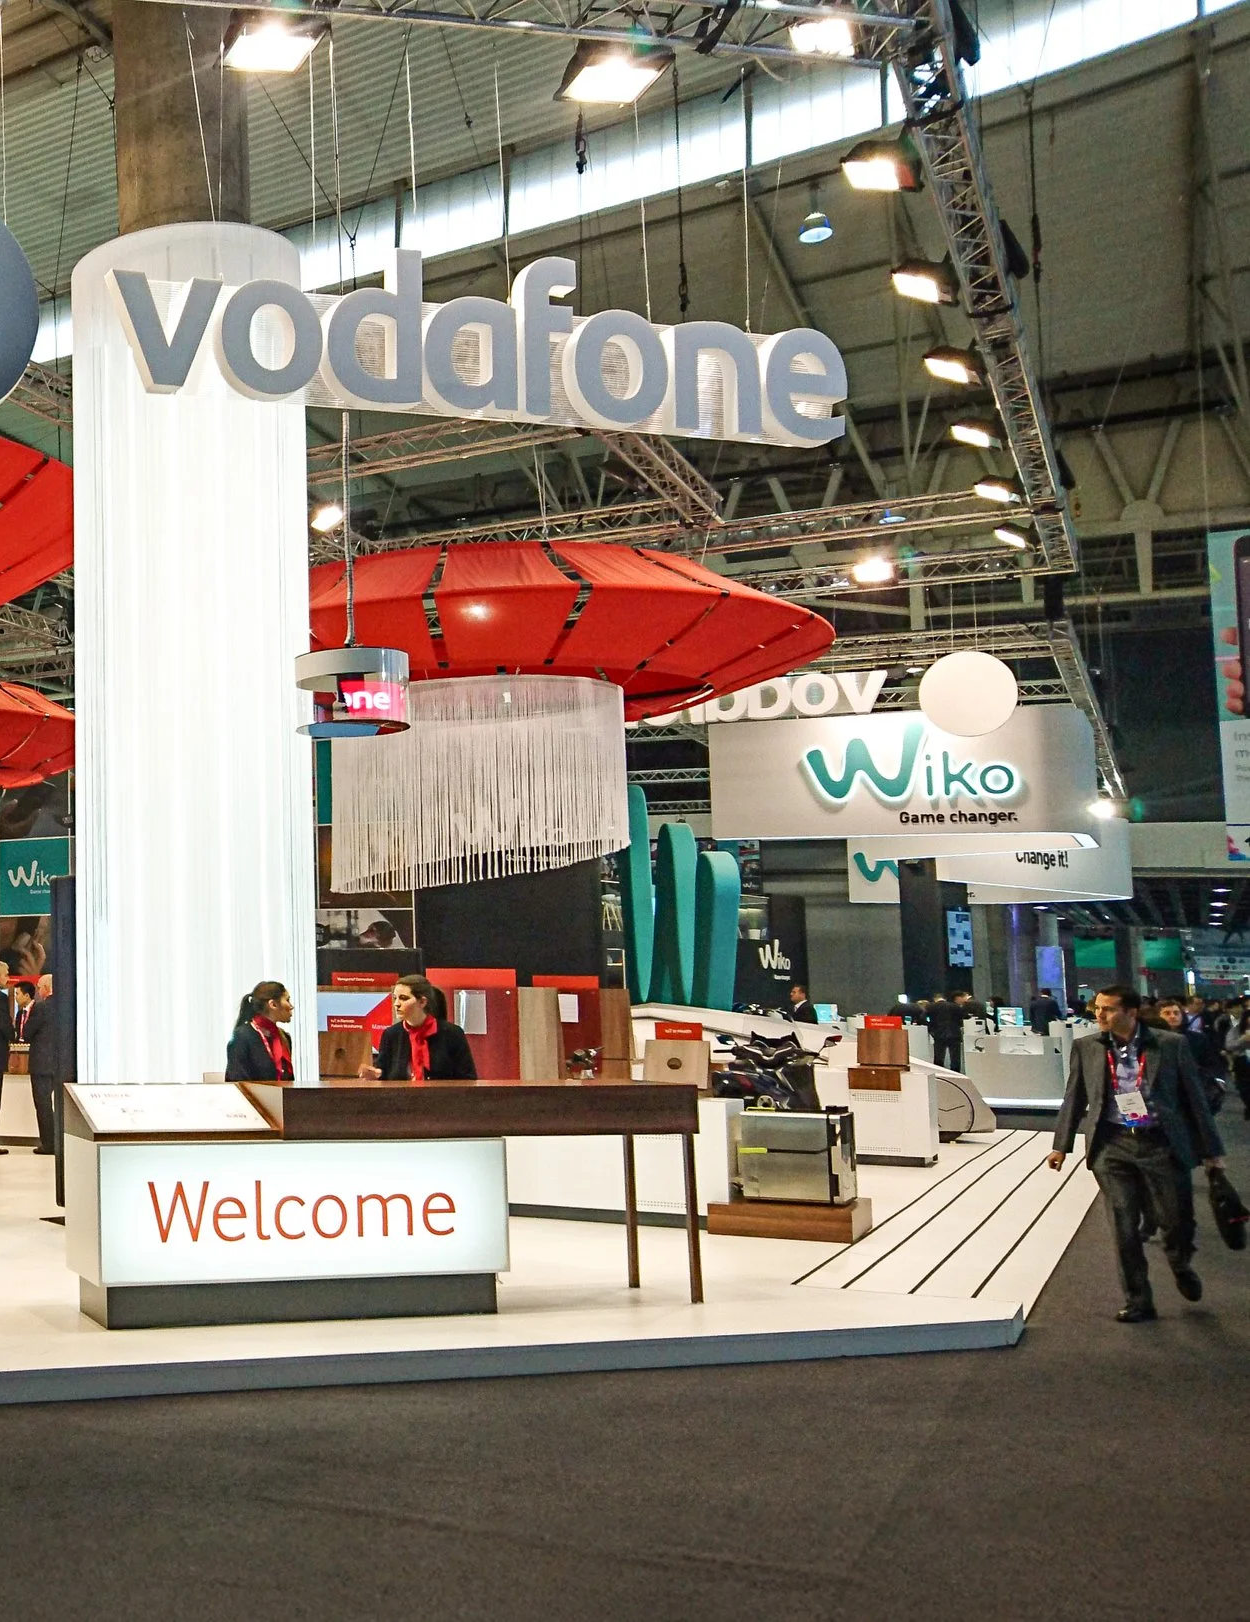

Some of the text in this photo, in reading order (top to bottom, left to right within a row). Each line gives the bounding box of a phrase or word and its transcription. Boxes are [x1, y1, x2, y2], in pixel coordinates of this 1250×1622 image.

[104, 249, 848, 441] vodafone
[806, 719, 1016, 799] Wiko
[899, 810, 1018, 825] Game changer.
[8, 860, 57, 888] Wik
[1057, 850, 1069, 868] it!
[758, 939, 791, 970] Wiko
[147, 1180, 456, 1243] Welcome
